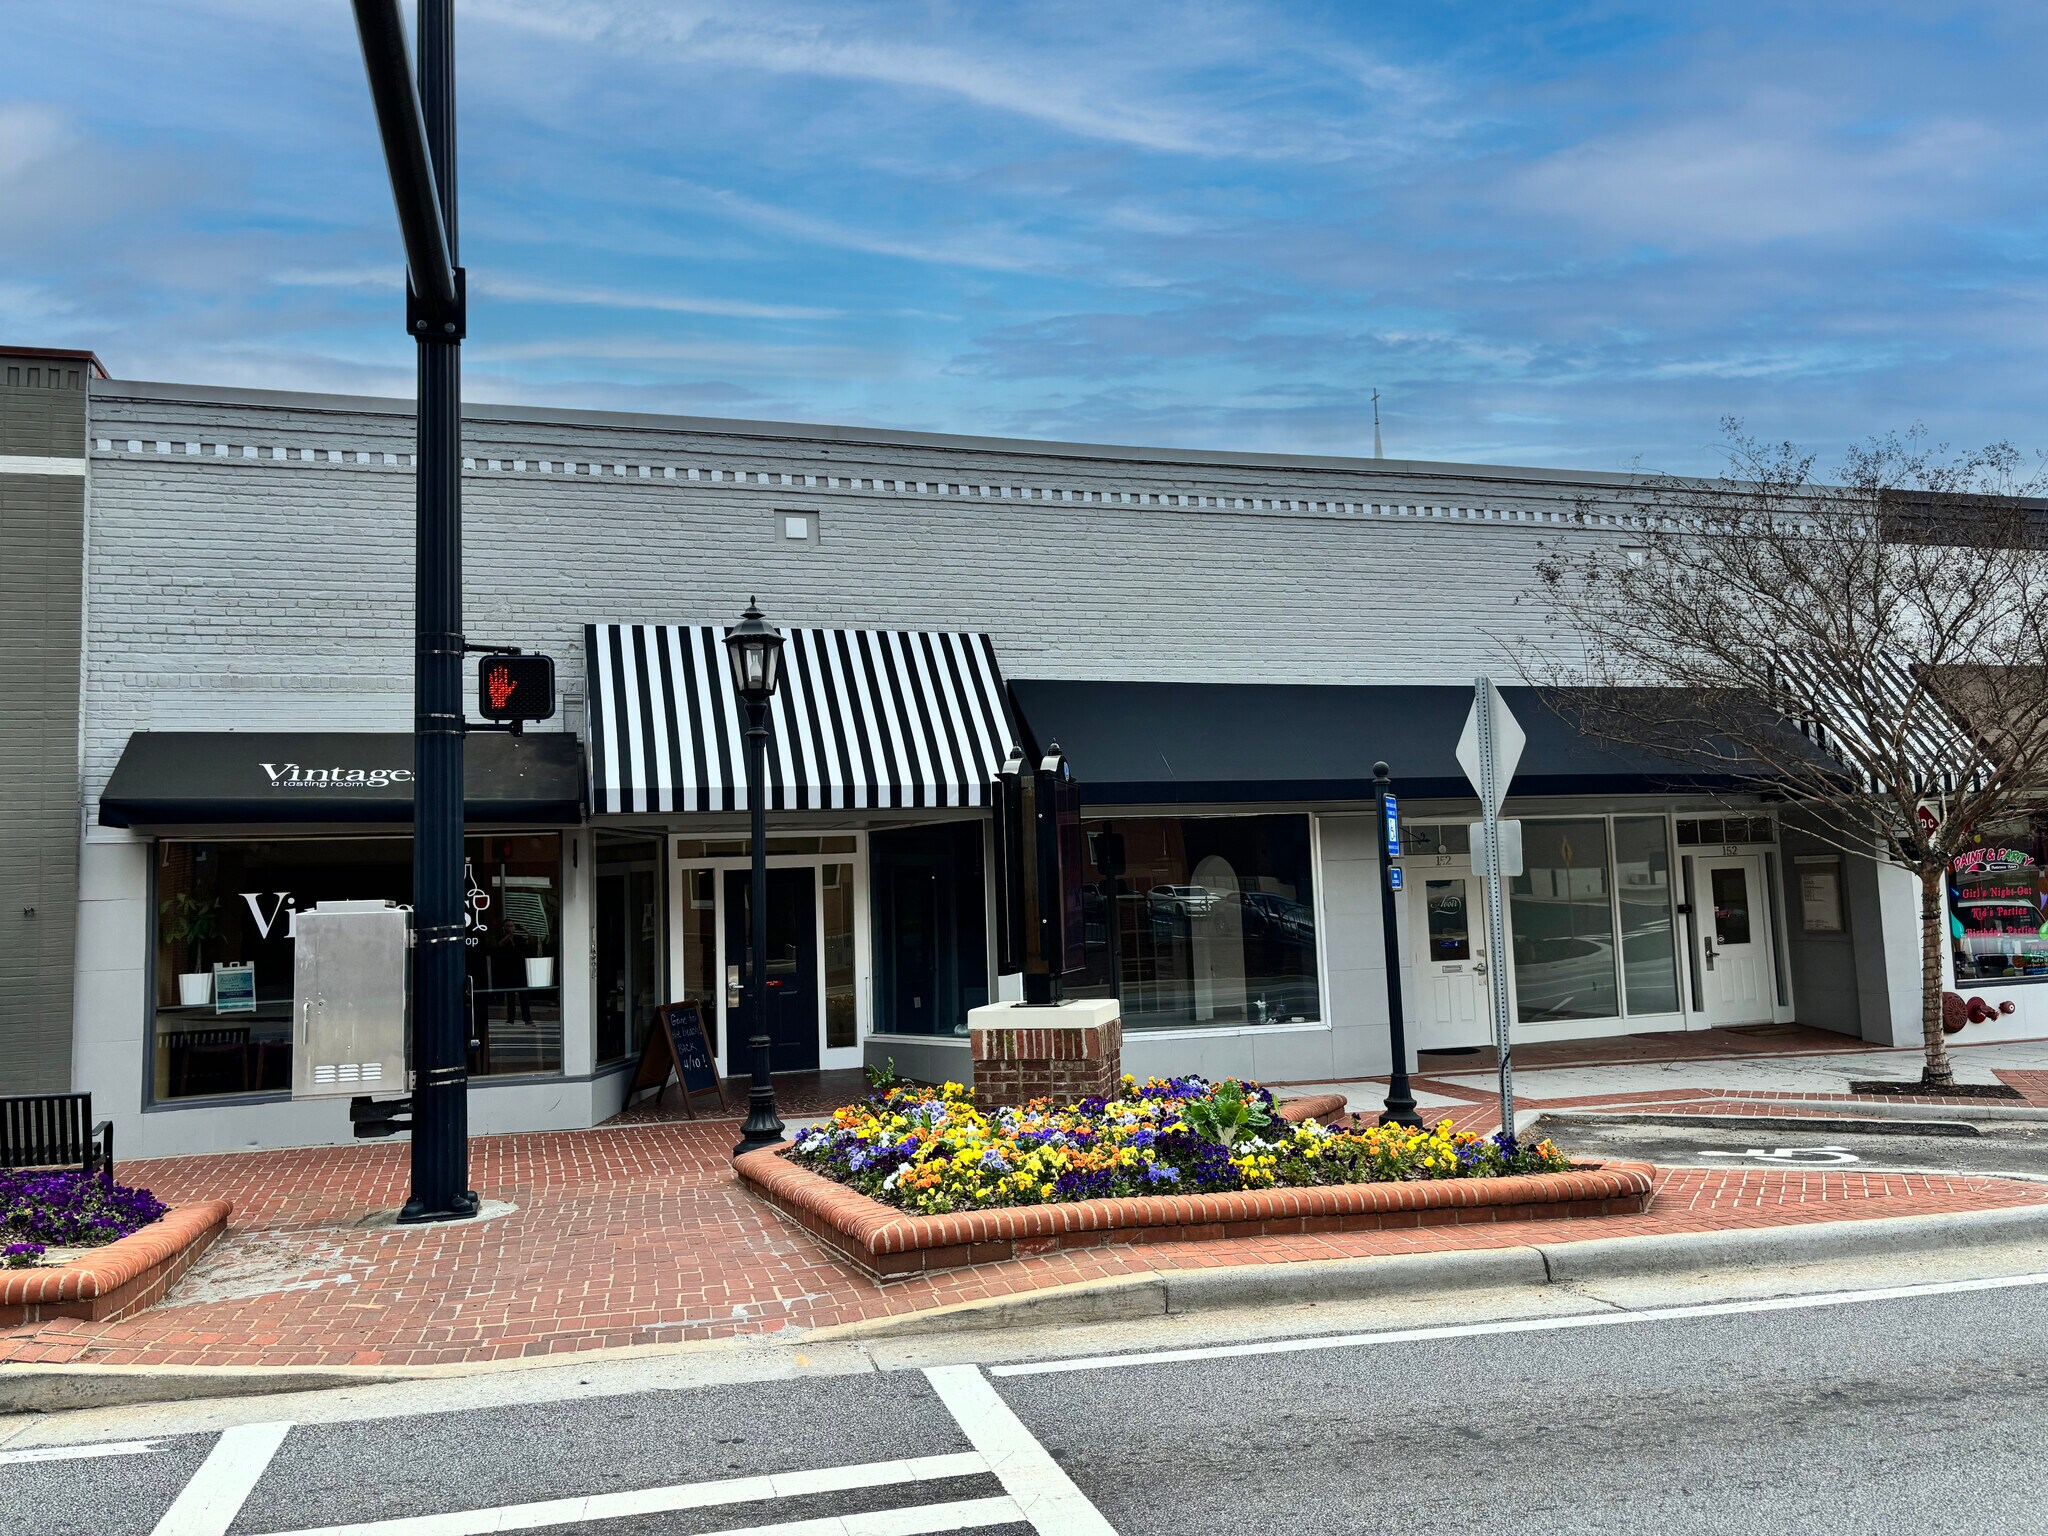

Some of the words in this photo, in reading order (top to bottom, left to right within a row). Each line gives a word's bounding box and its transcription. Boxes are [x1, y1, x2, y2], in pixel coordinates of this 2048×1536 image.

[283, 780, 327, 788] tasting
[1722, 846, 1738, 856] 152
[1953, 847, 1986, 872] PAINT
[1986, 847, 1995, 861] &
[1996, 847, 2034, 866] PARTY
[1962, 886, 1987, 899] Girl's
[1990, 886, 2015, 898] Night
[2017, 885, 2032, 897] Out
[1972, 906, 1994, 920] Kid's
[1997, 906, 2027, 917] Parties
[1965, 926, 2003, 938] Birthday
[2006, 925, 2037, 936] Parties
[670, 1013, 687, 1026] Gone
